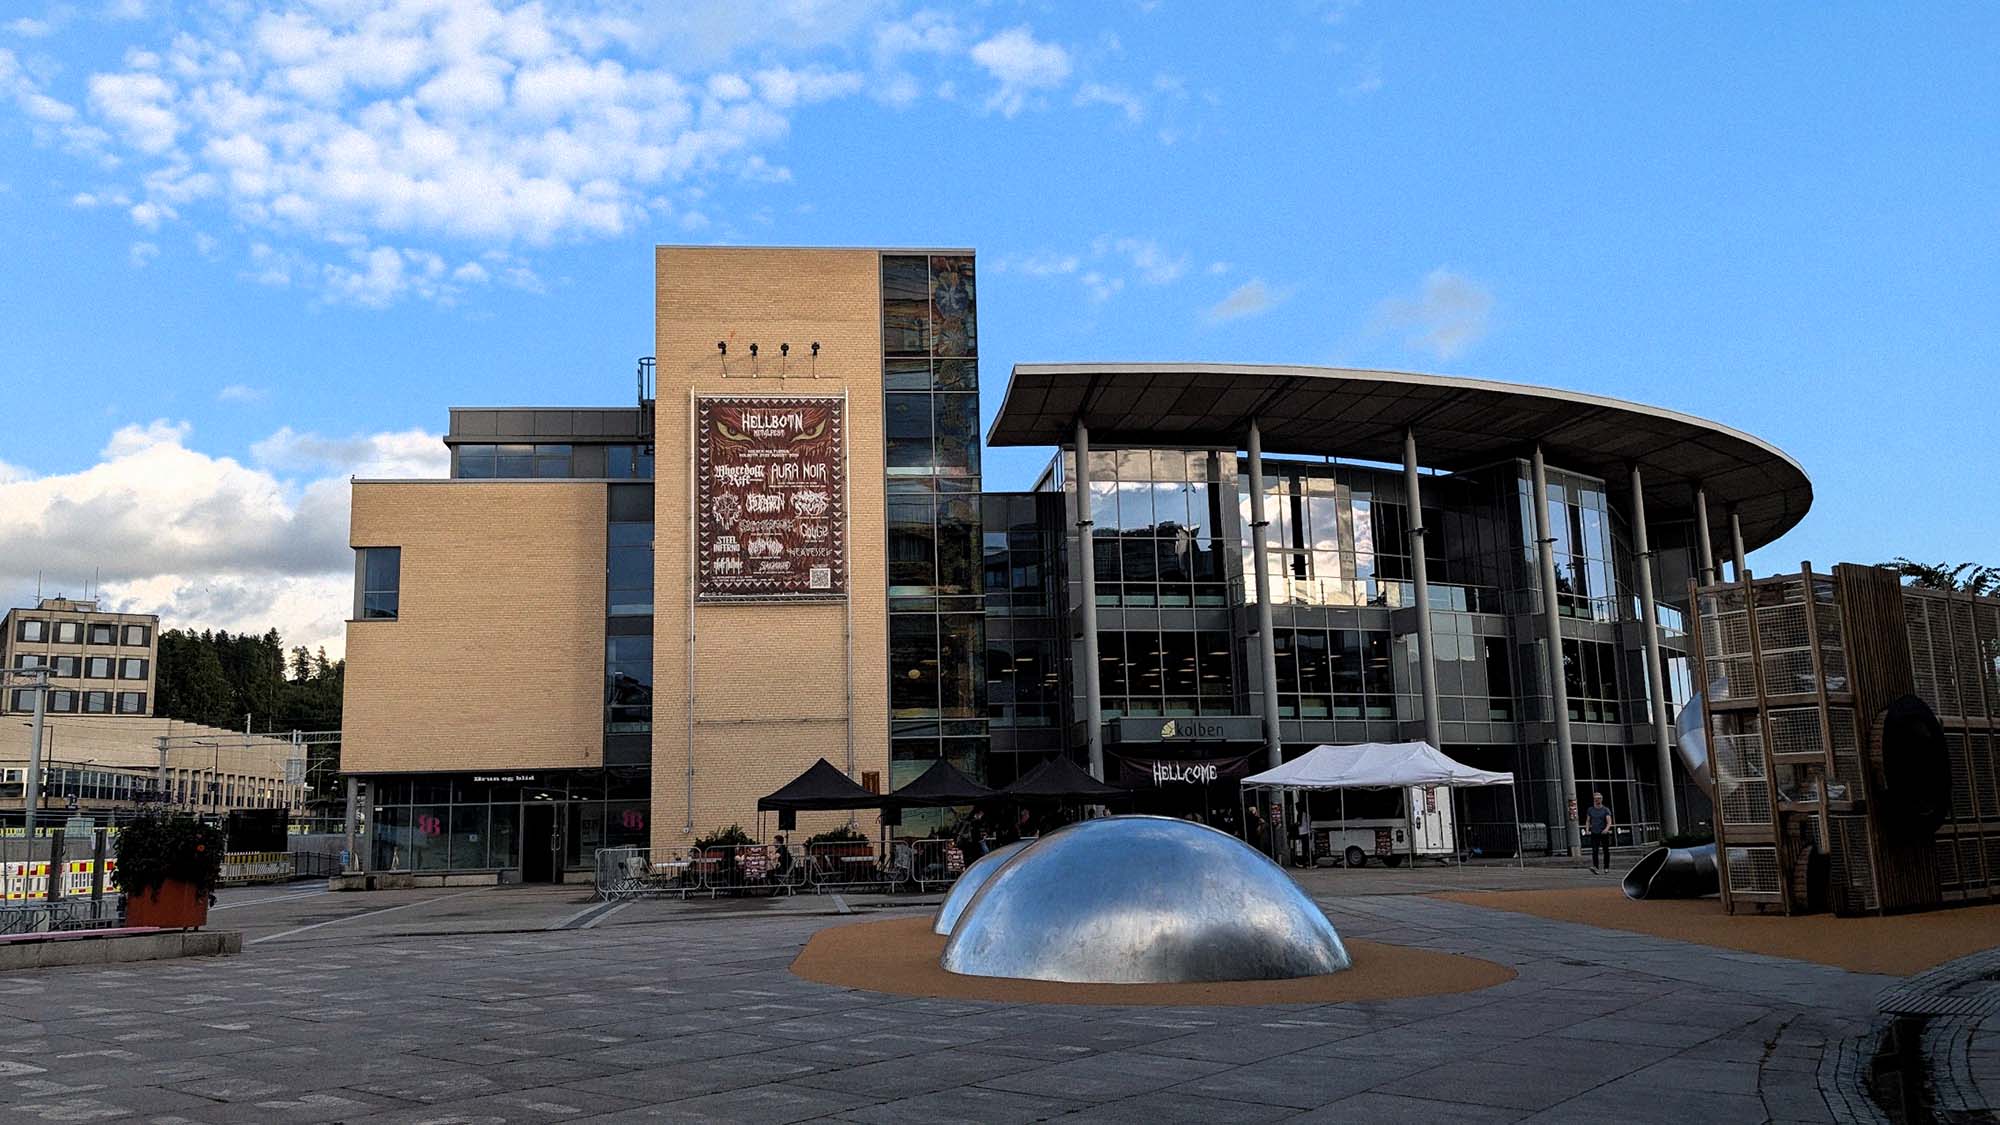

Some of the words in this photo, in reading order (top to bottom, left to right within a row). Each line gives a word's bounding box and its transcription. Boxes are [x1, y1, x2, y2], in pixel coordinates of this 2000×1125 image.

[741, 411, 804, 433] HELLBOTN
[771, 462, 799, 484] AURA
[802, 460, 827, 484] NOIR
[716, 536, 737, 544] STEEL
[1176, 720, 1224, 737] kolben
[1152, 759, 1218, 788] HELLCOME
